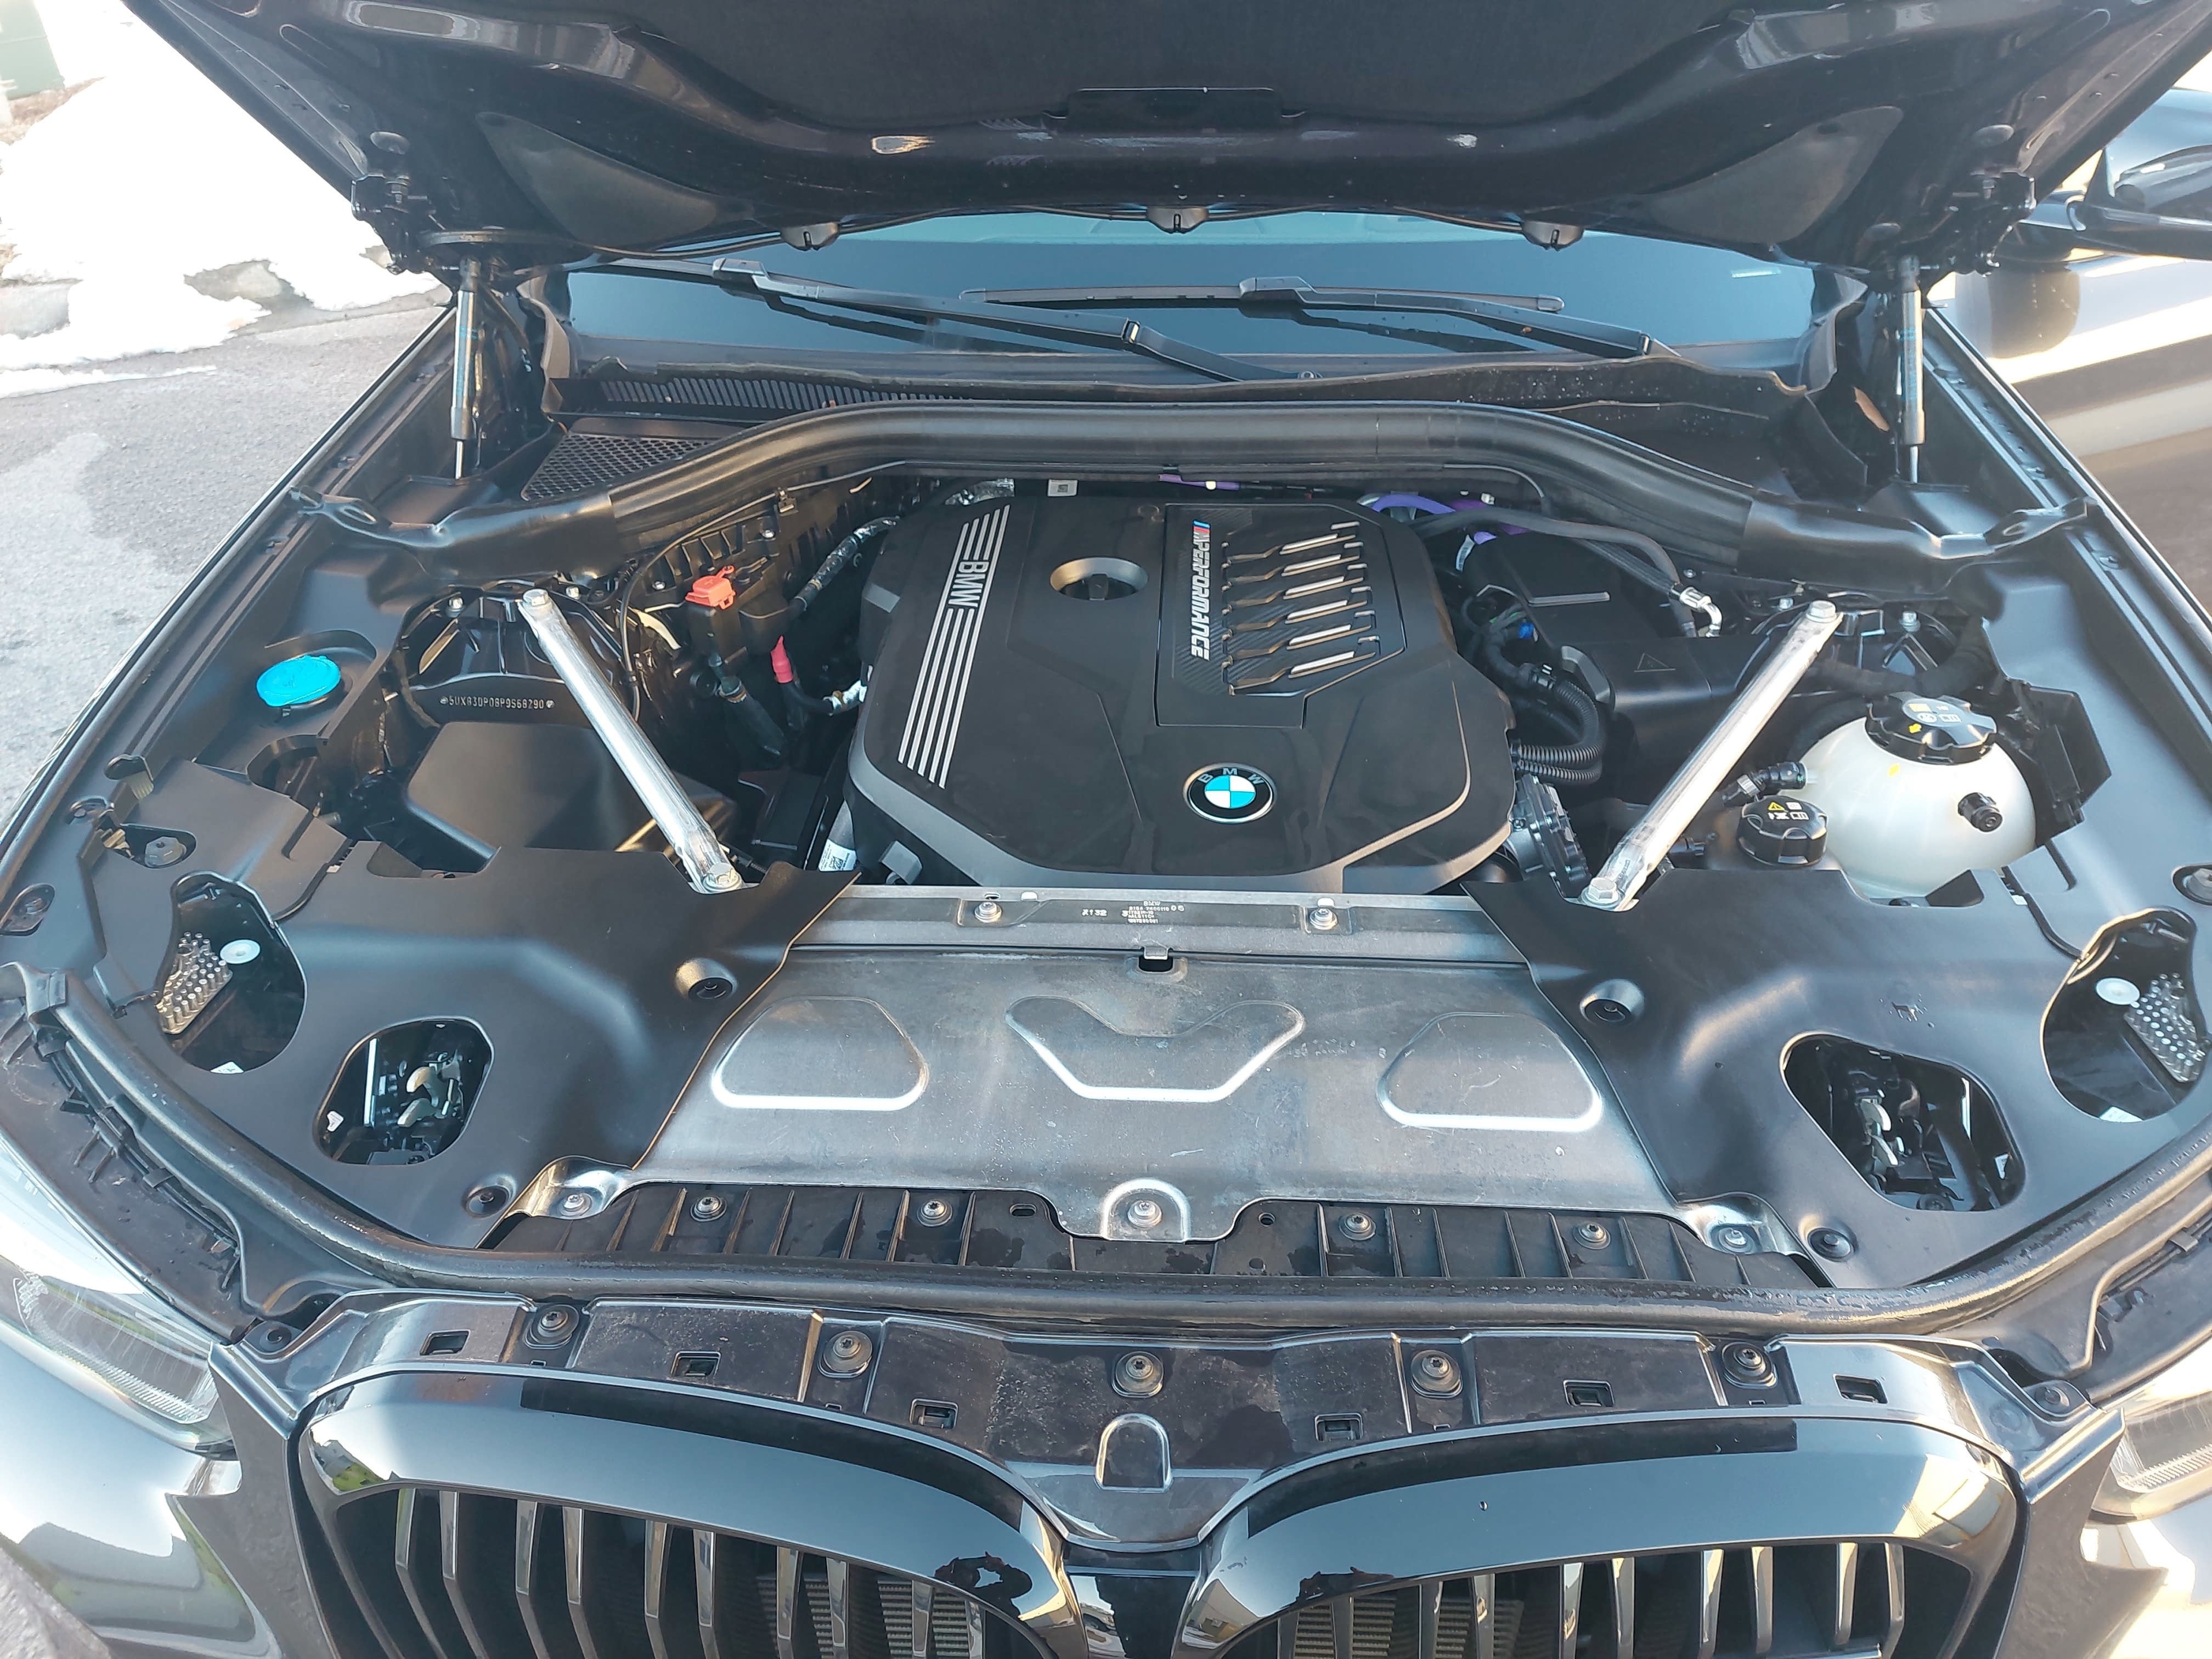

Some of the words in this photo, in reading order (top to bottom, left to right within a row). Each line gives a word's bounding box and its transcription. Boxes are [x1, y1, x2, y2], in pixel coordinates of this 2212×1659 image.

[947, 559, 990, 608] BMW
[1190, 540, 1211, 661] PERFORMANCE
[1197, 768, 1265, 785] BMW
